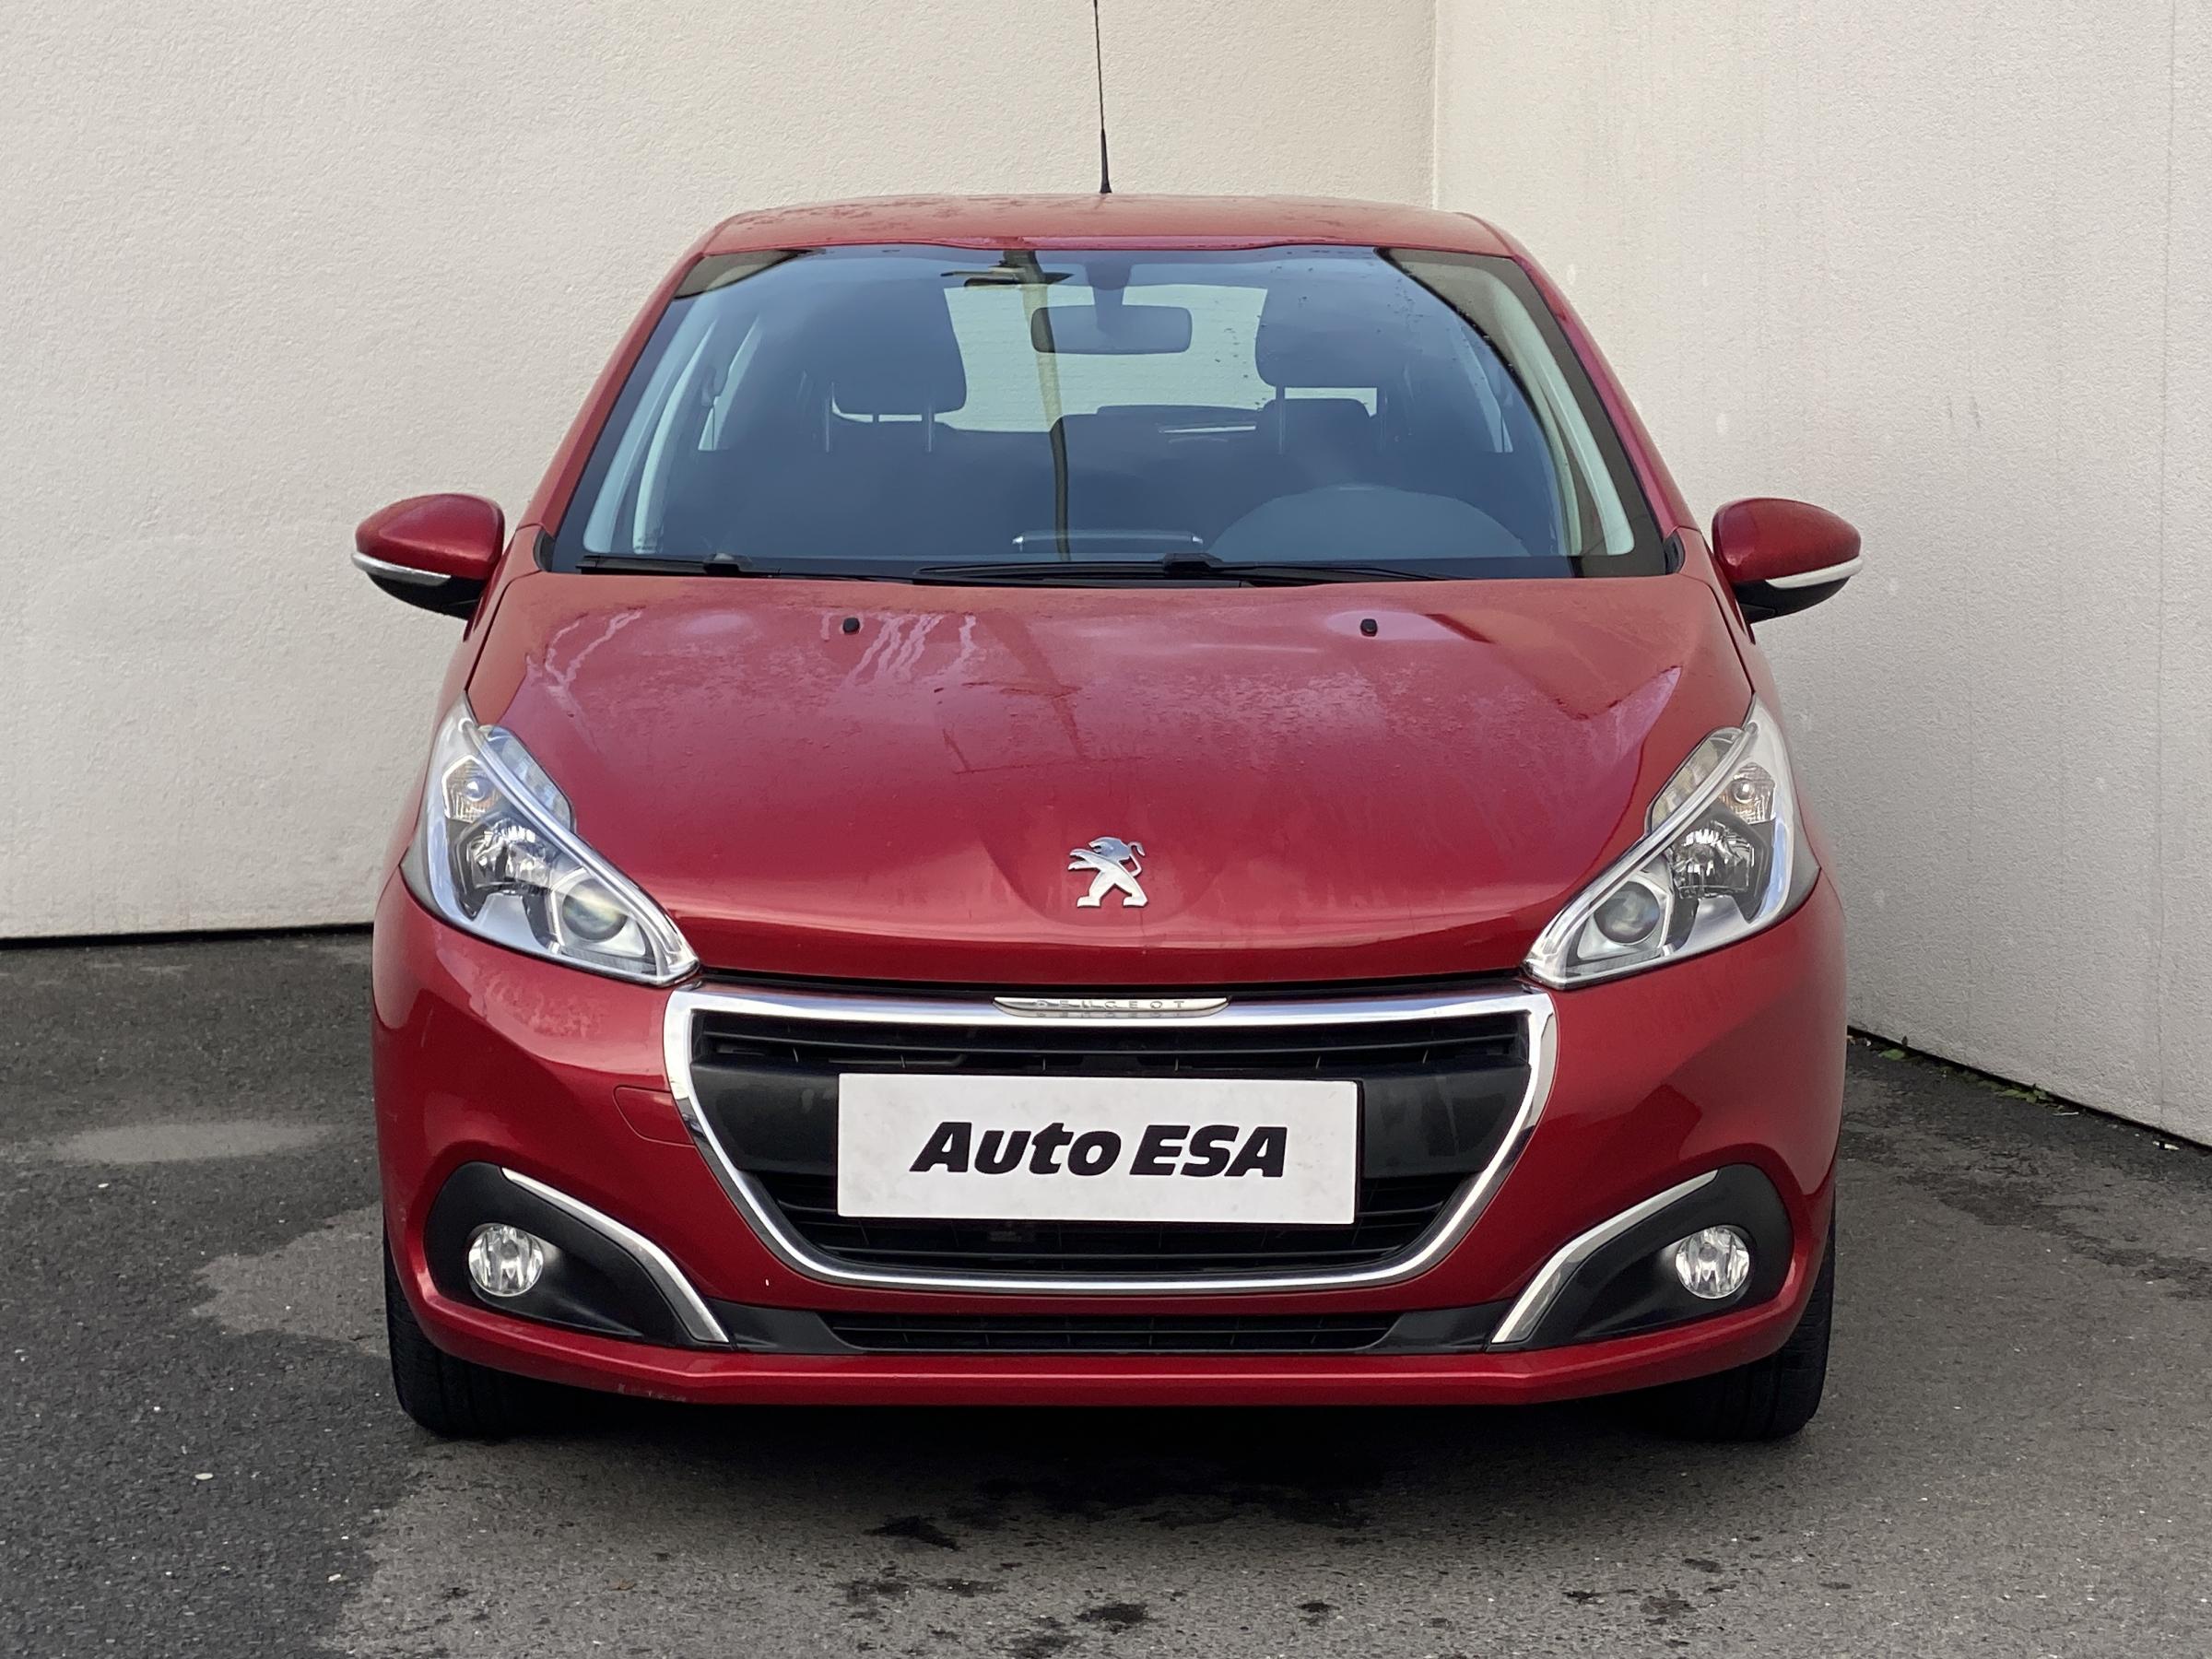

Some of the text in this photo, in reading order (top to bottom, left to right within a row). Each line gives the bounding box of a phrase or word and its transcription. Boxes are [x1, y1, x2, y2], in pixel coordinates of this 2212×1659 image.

[1035, 999, 1185, 1010] PEUGEOT
[909, 1122, 1288, 1178] Auto ESA
